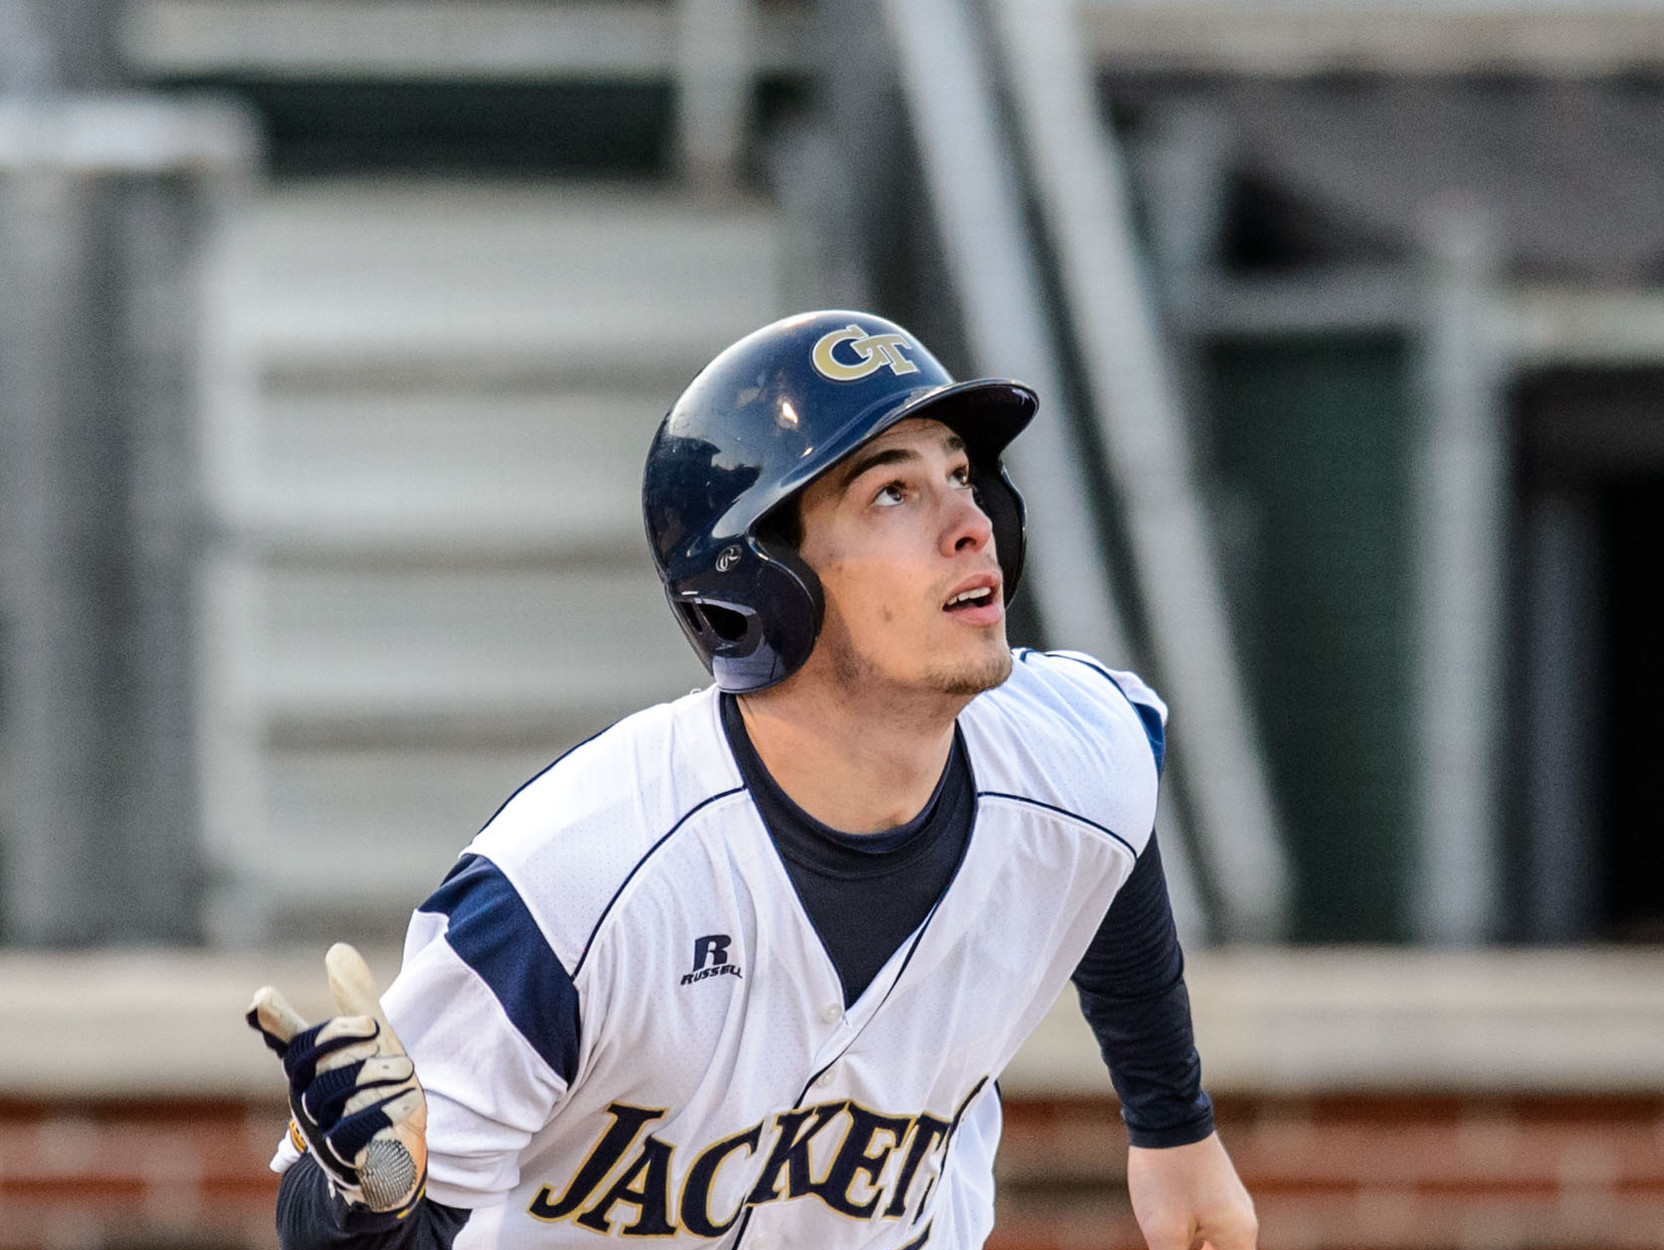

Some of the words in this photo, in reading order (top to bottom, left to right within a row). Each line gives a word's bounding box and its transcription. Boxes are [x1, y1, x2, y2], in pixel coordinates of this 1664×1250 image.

[812, 323, 921, 381] GT
[693, 934, 732, 973] R
[680, 964, 743, 986] RUSSELL
